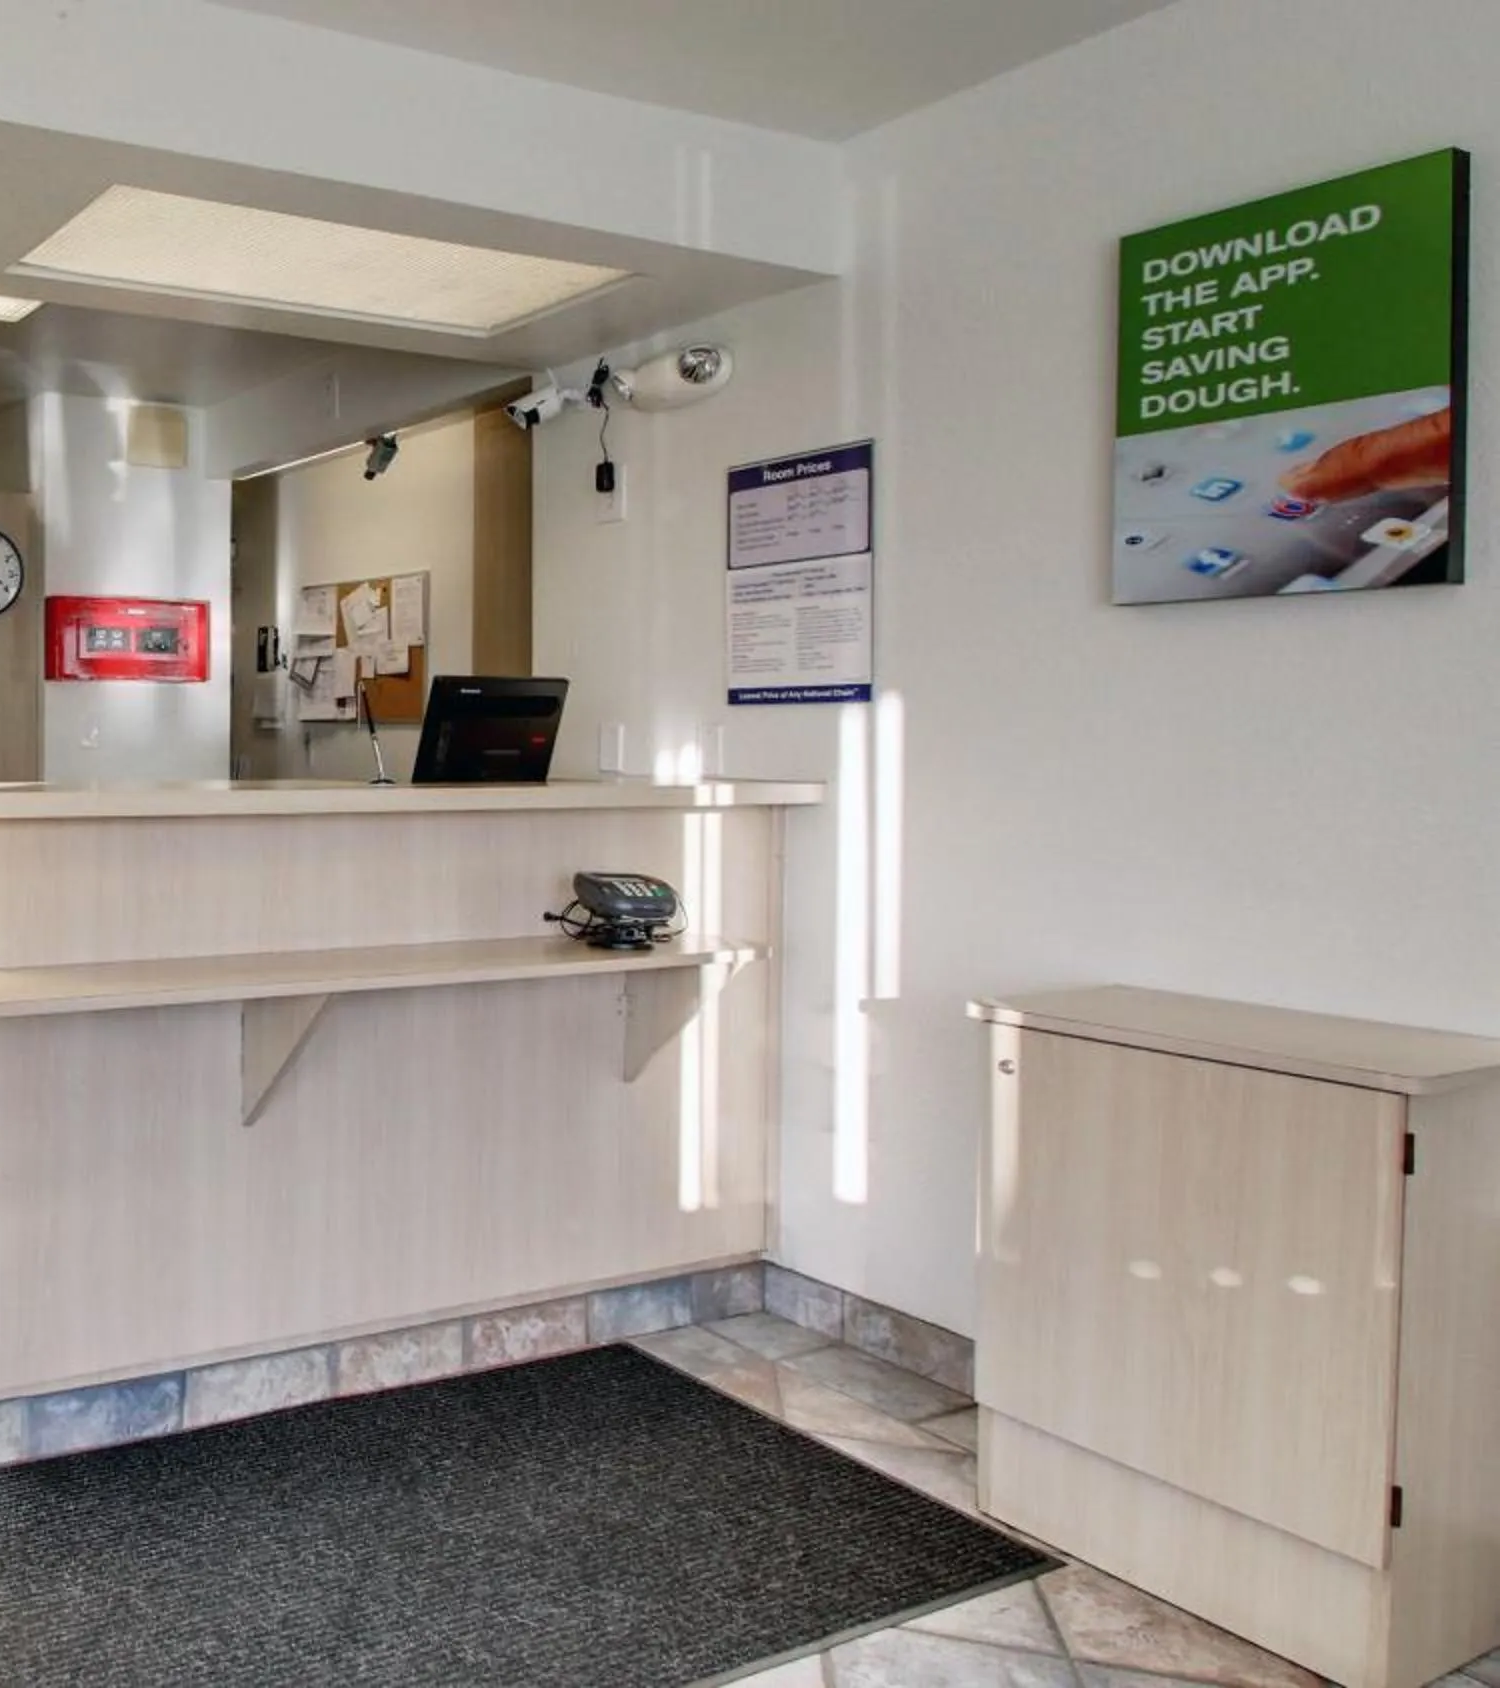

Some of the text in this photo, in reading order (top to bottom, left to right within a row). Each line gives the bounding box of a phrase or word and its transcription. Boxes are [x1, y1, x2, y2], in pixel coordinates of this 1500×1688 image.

[1142, 204, 1382, 283] DOWNLOAD
[1141, 256, 1320, 316] THE APP.
[1141, 304, 1264, 351] START
[1140, 336, 1291, 385] SAVING
[1140, 371, 1301, 419] DOUGH.
[763, 460, 833, 482] Room Prices
